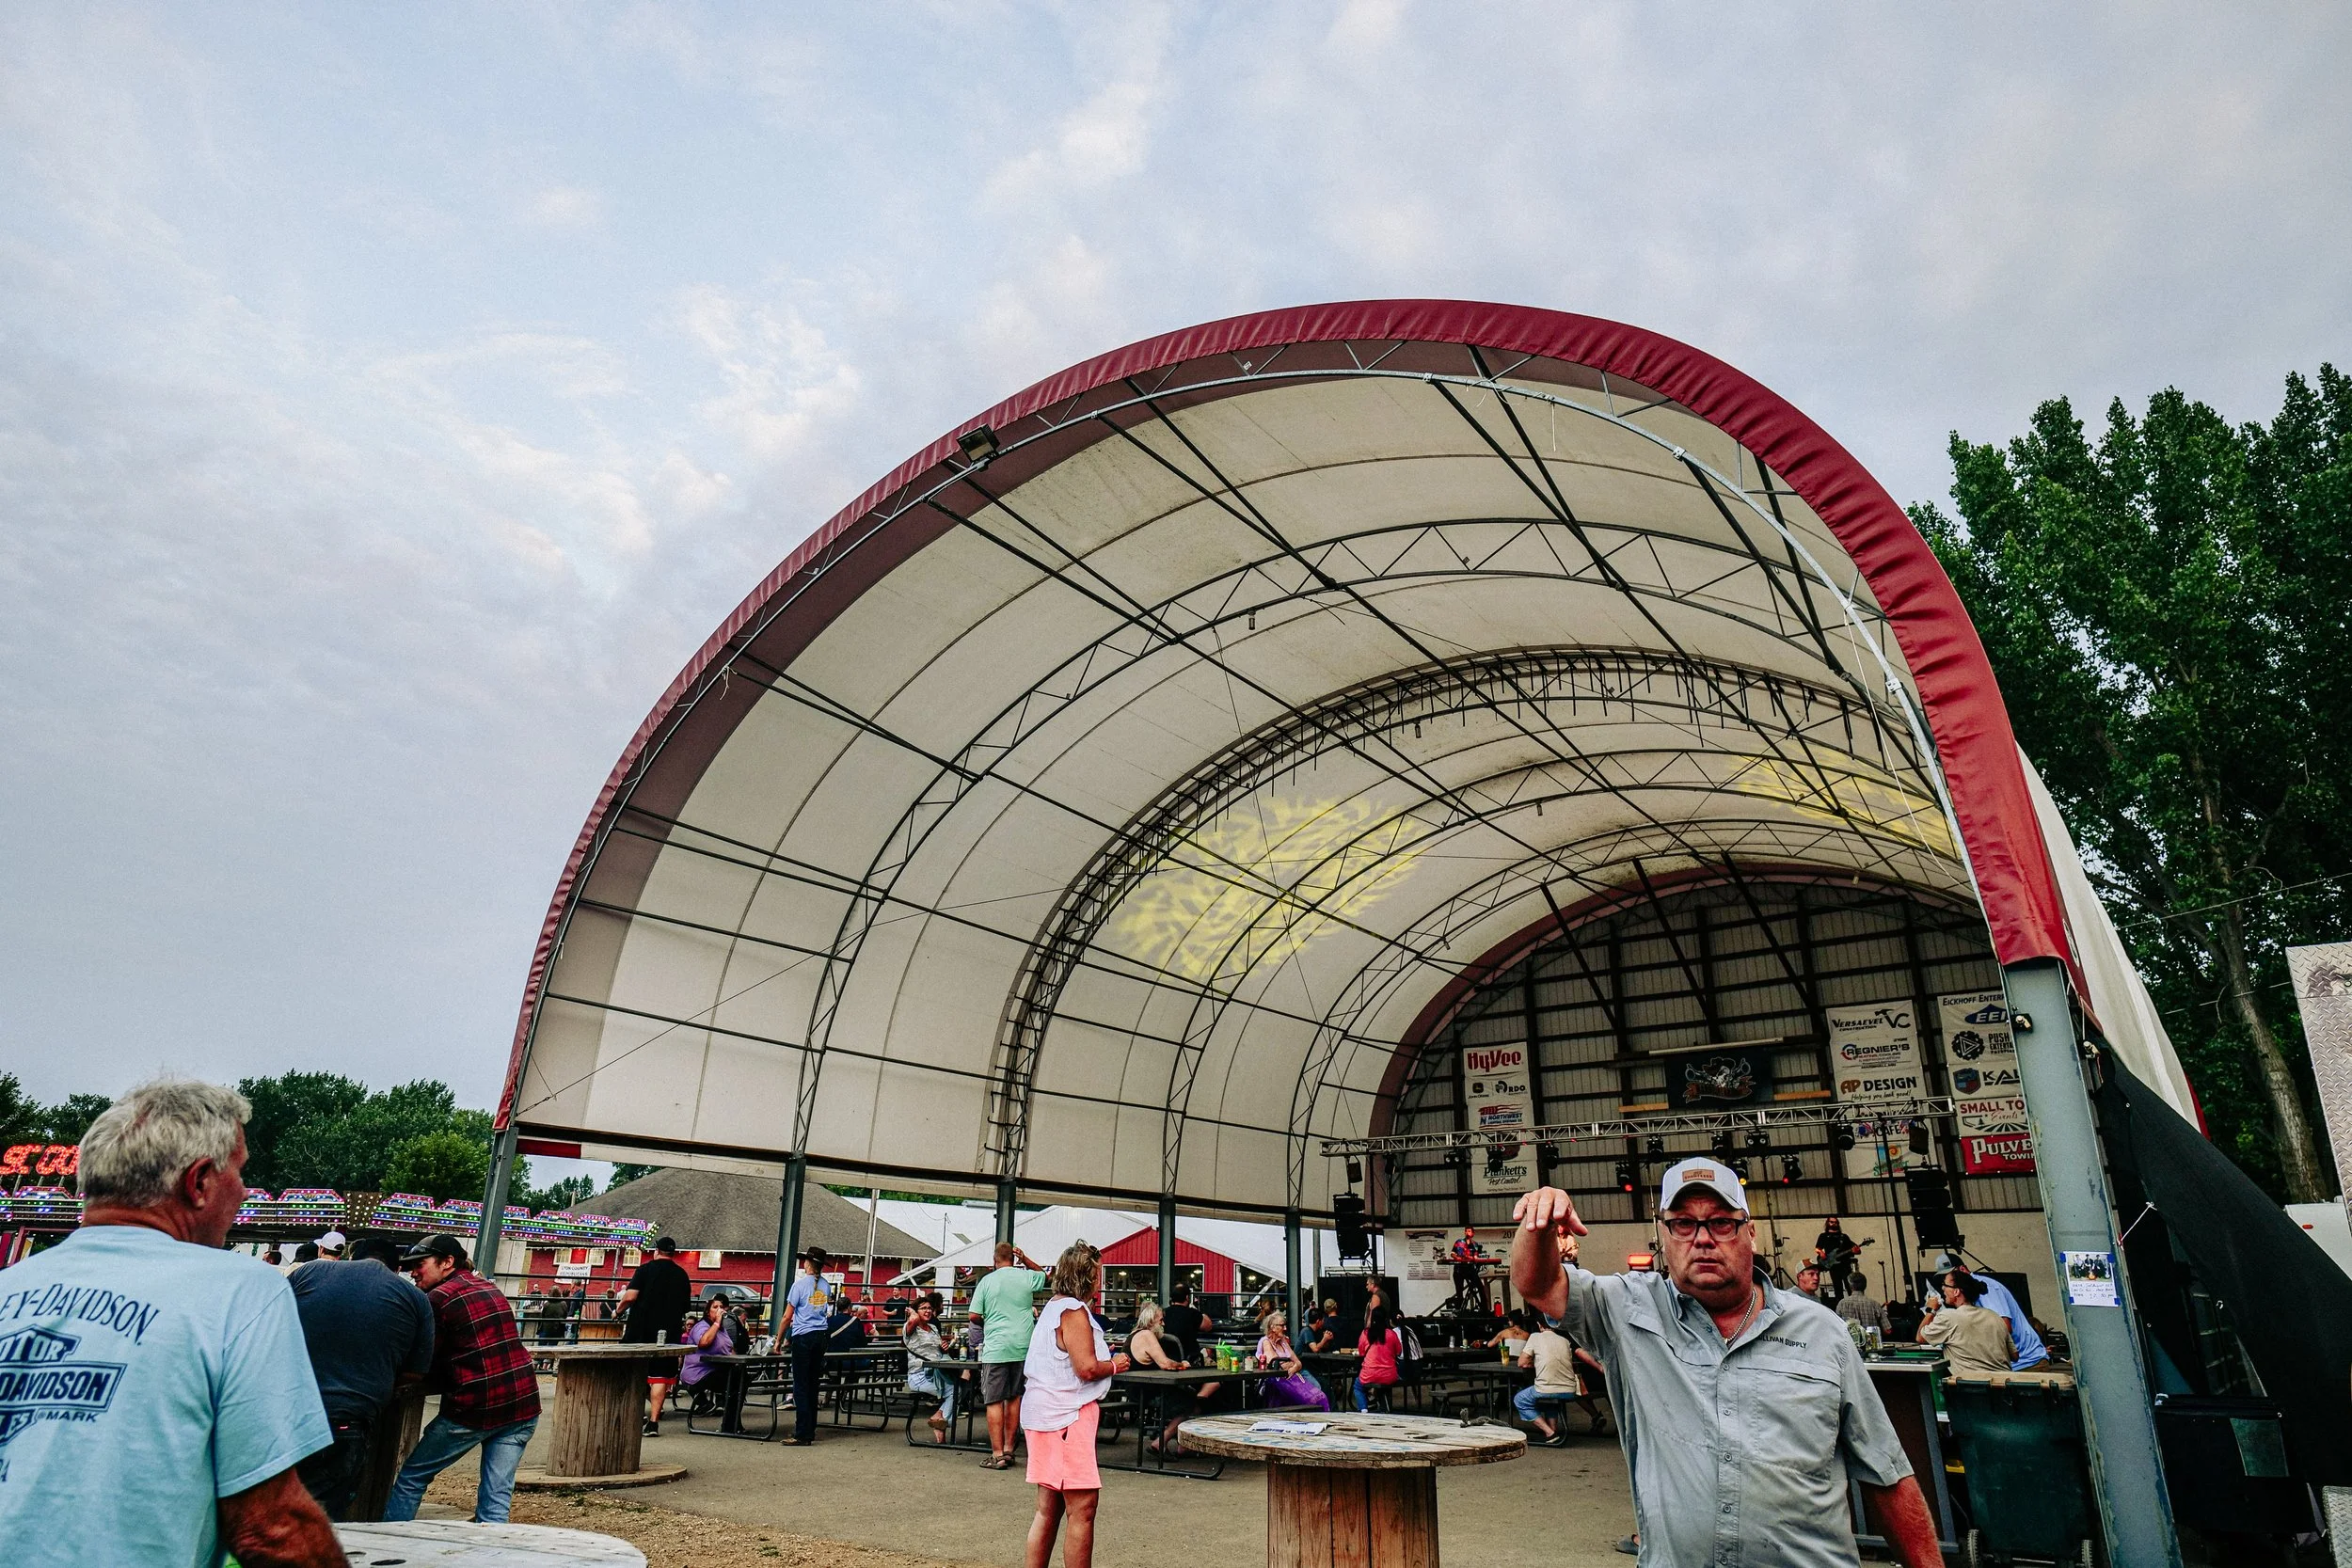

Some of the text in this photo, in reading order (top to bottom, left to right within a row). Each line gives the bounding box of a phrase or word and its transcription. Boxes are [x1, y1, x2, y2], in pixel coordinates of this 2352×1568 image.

[1943, 997, 1976, 1006] EICKHOFF
[1977, 1011, 2006, 1022] EEI
[1832, 1018, 1883, 1028] VERSAEVEL
[1988, 1033, 2010, 1043] PUSH
[1847, 1044, 1910, 1055] REGNIER'S
[1840, 1076, 1917, 1094] AP DESIGN
[1960, 1100, 2025, 1114] SMALL TO
[1971, 1138, 2032, 1164] PULVE
[1484, 1166, 1527, 1177] Pnkett's
[1785, 1338, 1806, 1348] SUPPLY
